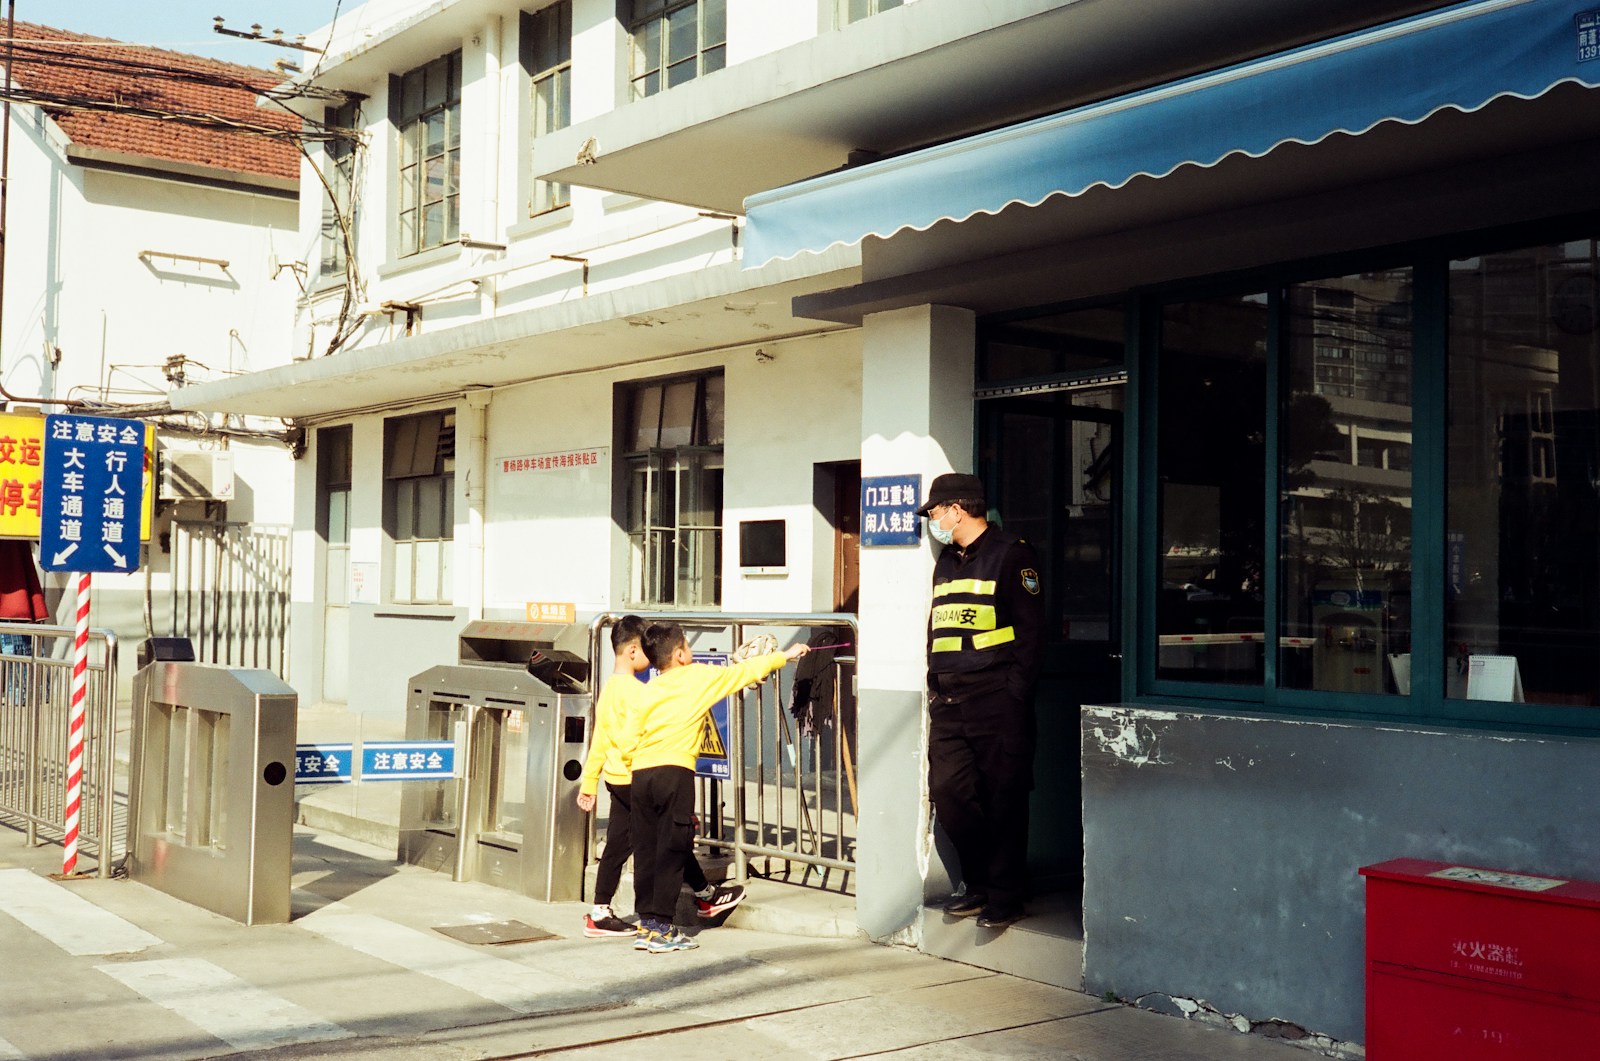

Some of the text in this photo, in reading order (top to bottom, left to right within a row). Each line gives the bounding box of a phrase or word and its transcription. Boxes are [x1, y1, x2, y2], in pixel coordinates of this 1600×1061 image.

[52, 420, 139, 445] 注意安全
[0, 435, 41, 466] 交运
[503, 452, 598, 473] 曹杨路停车场宣传海报张贴区
[59, 448, 86, 542] 大车通道
[101, 450, 128, 543] 行人通道
[866, 484, 915, 507] 门卫重地
[865, 511, 915, 533] 闲人免进
[960, 608, 977, 626] 安
[374, 751, 443, 770] 注意安全
